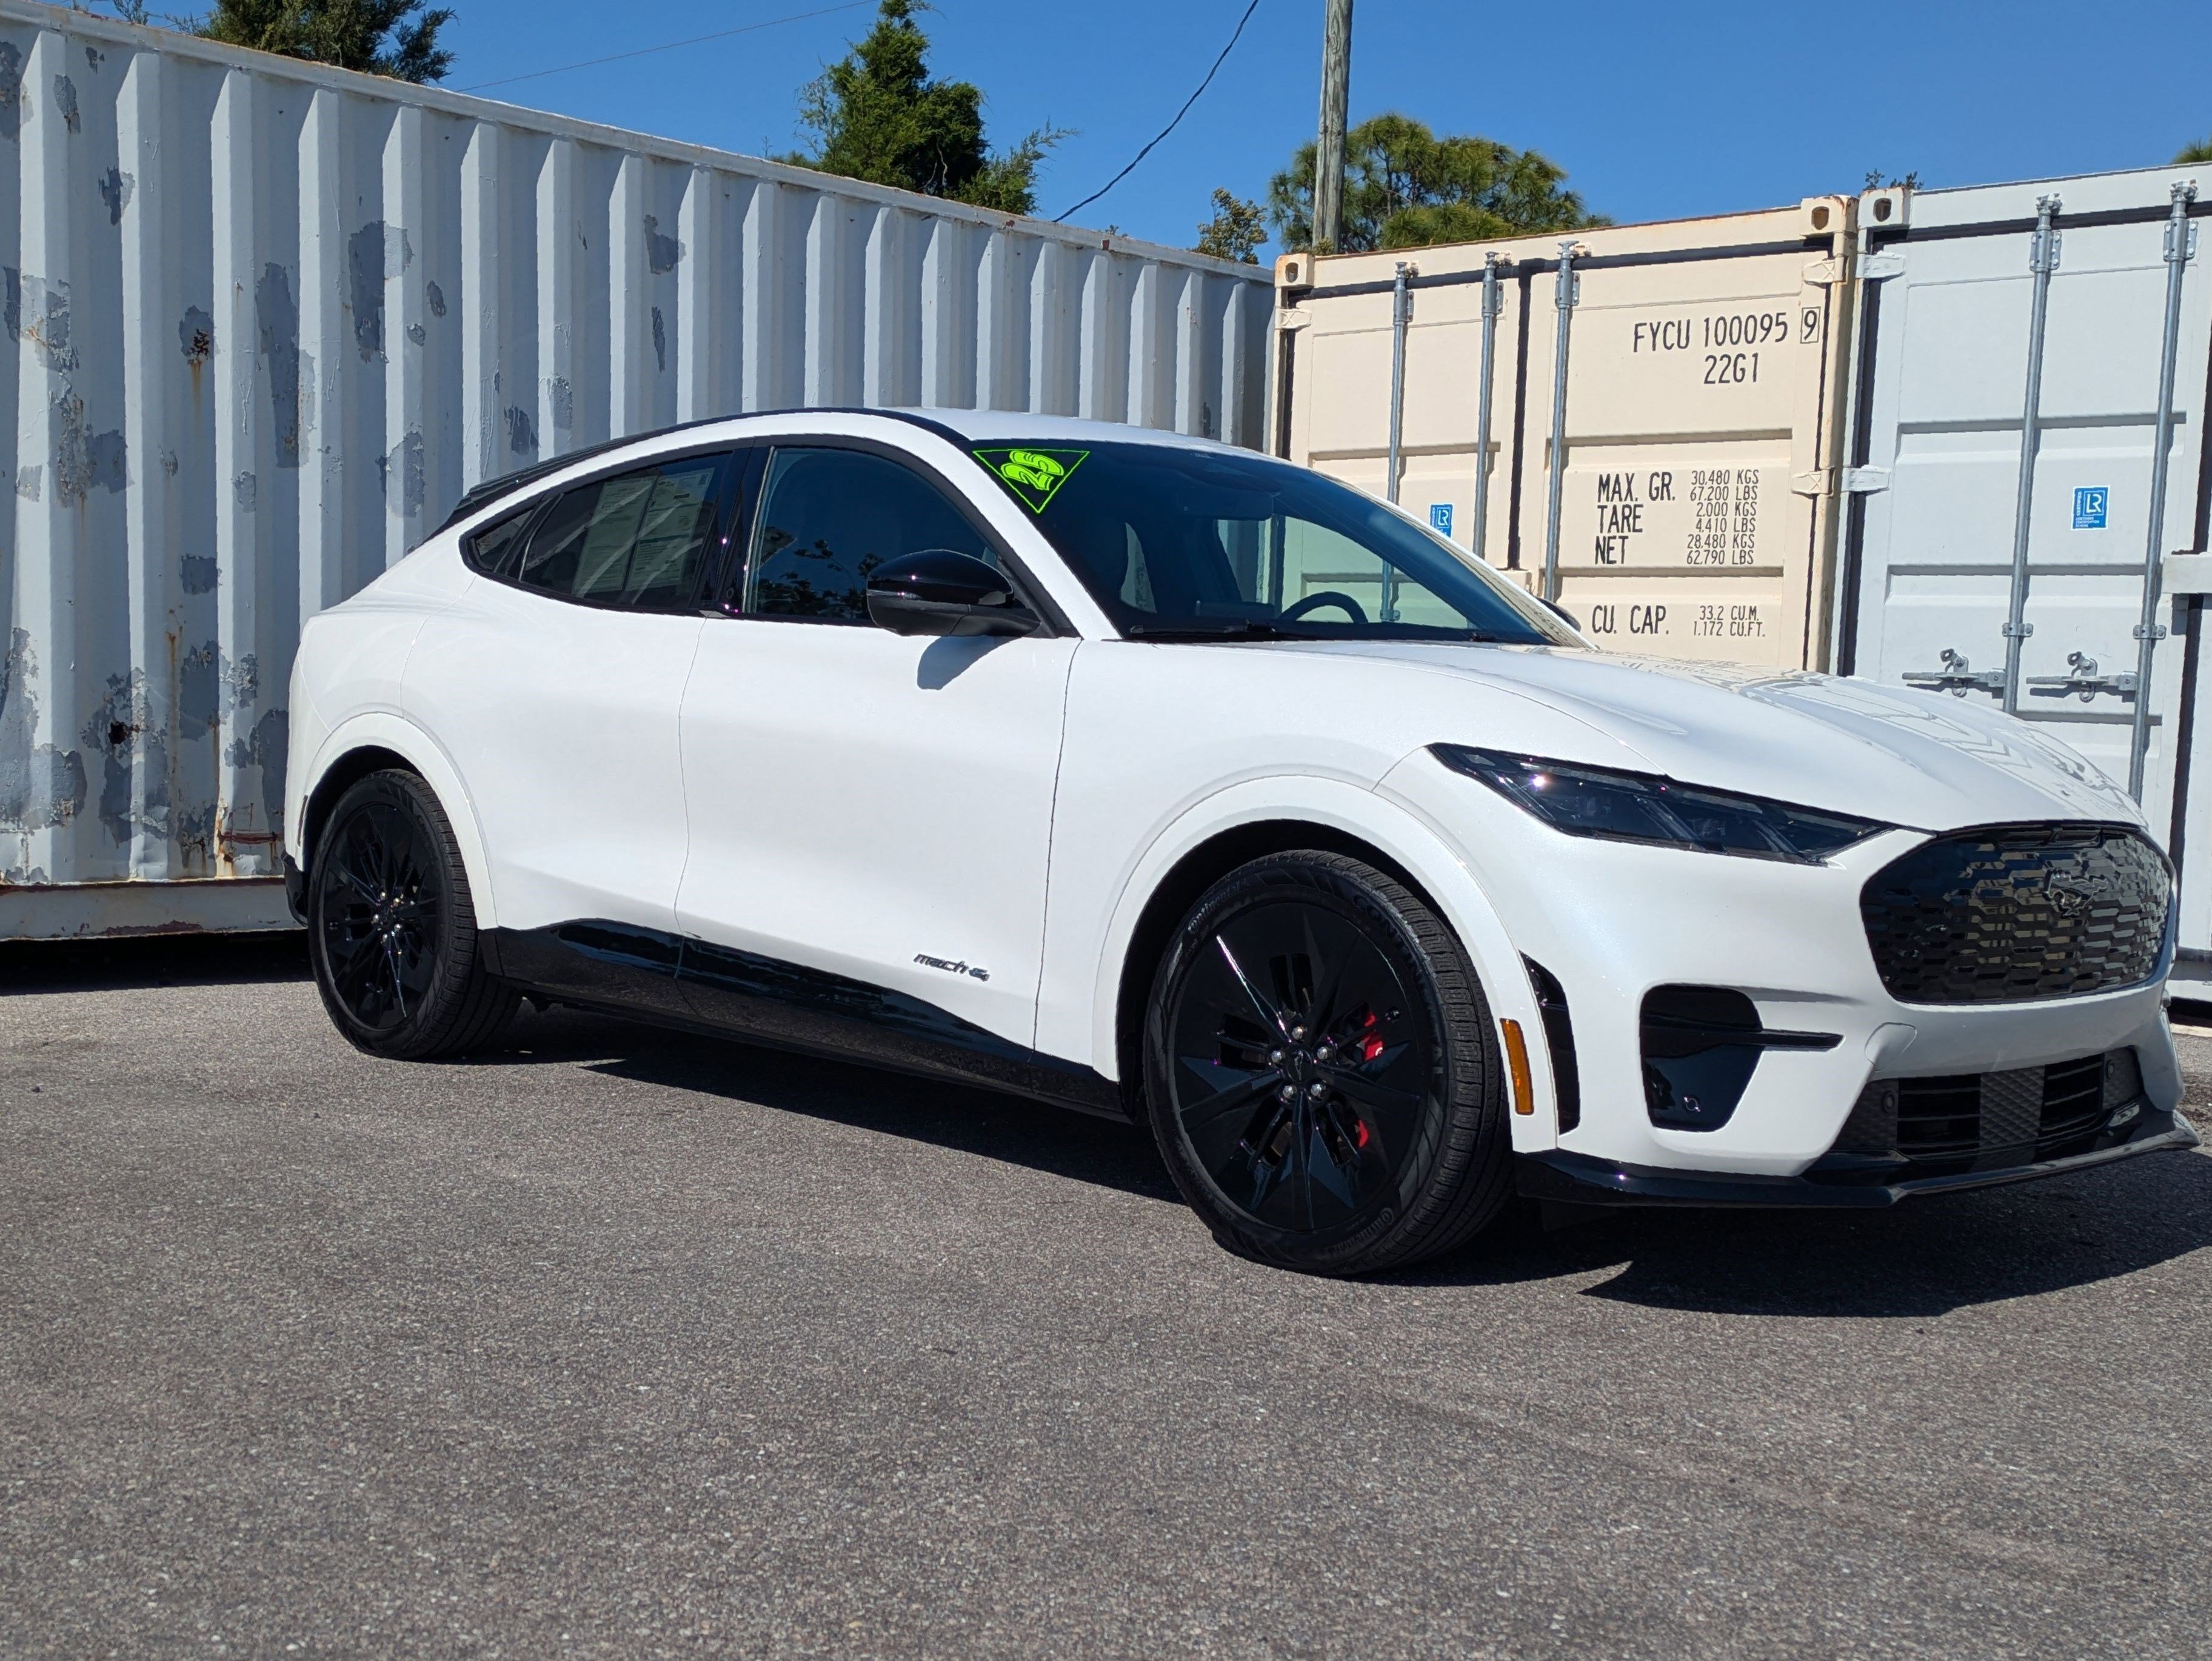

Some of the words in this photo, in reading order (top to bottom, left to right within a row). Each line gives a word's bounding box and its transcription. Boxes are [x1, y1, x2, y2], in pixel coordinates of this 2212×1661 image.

[1634, 319, 1690, 352] FYCU
[1704, 312, 1788, 347] 100095
[1804, 310, 1817, 340] 9
[1704, 353, 1758, 384] 22G1
[1598, 473, 1638, 503] MAX.
[1649, 472, 1675, 501] GR.
[1737, 470, 1759, 486] KGS
[1736, 486, 1757, 501] LBS
[1597, 504, 1643, 533] TARE
[1735, 502, 1757, 517] KGS
[1734, 517, 1756, 532] LBS
[1595, 535, 1628, 564] NET
[1733, 533, 1754, 549] KGS
[1732, 549, 1753, 564] LBS
[1592, 605, 1617, 633] CU.
[1630, 605, 1668, 634] CAP.
[1700, 606, 1723, 620] 33.2
